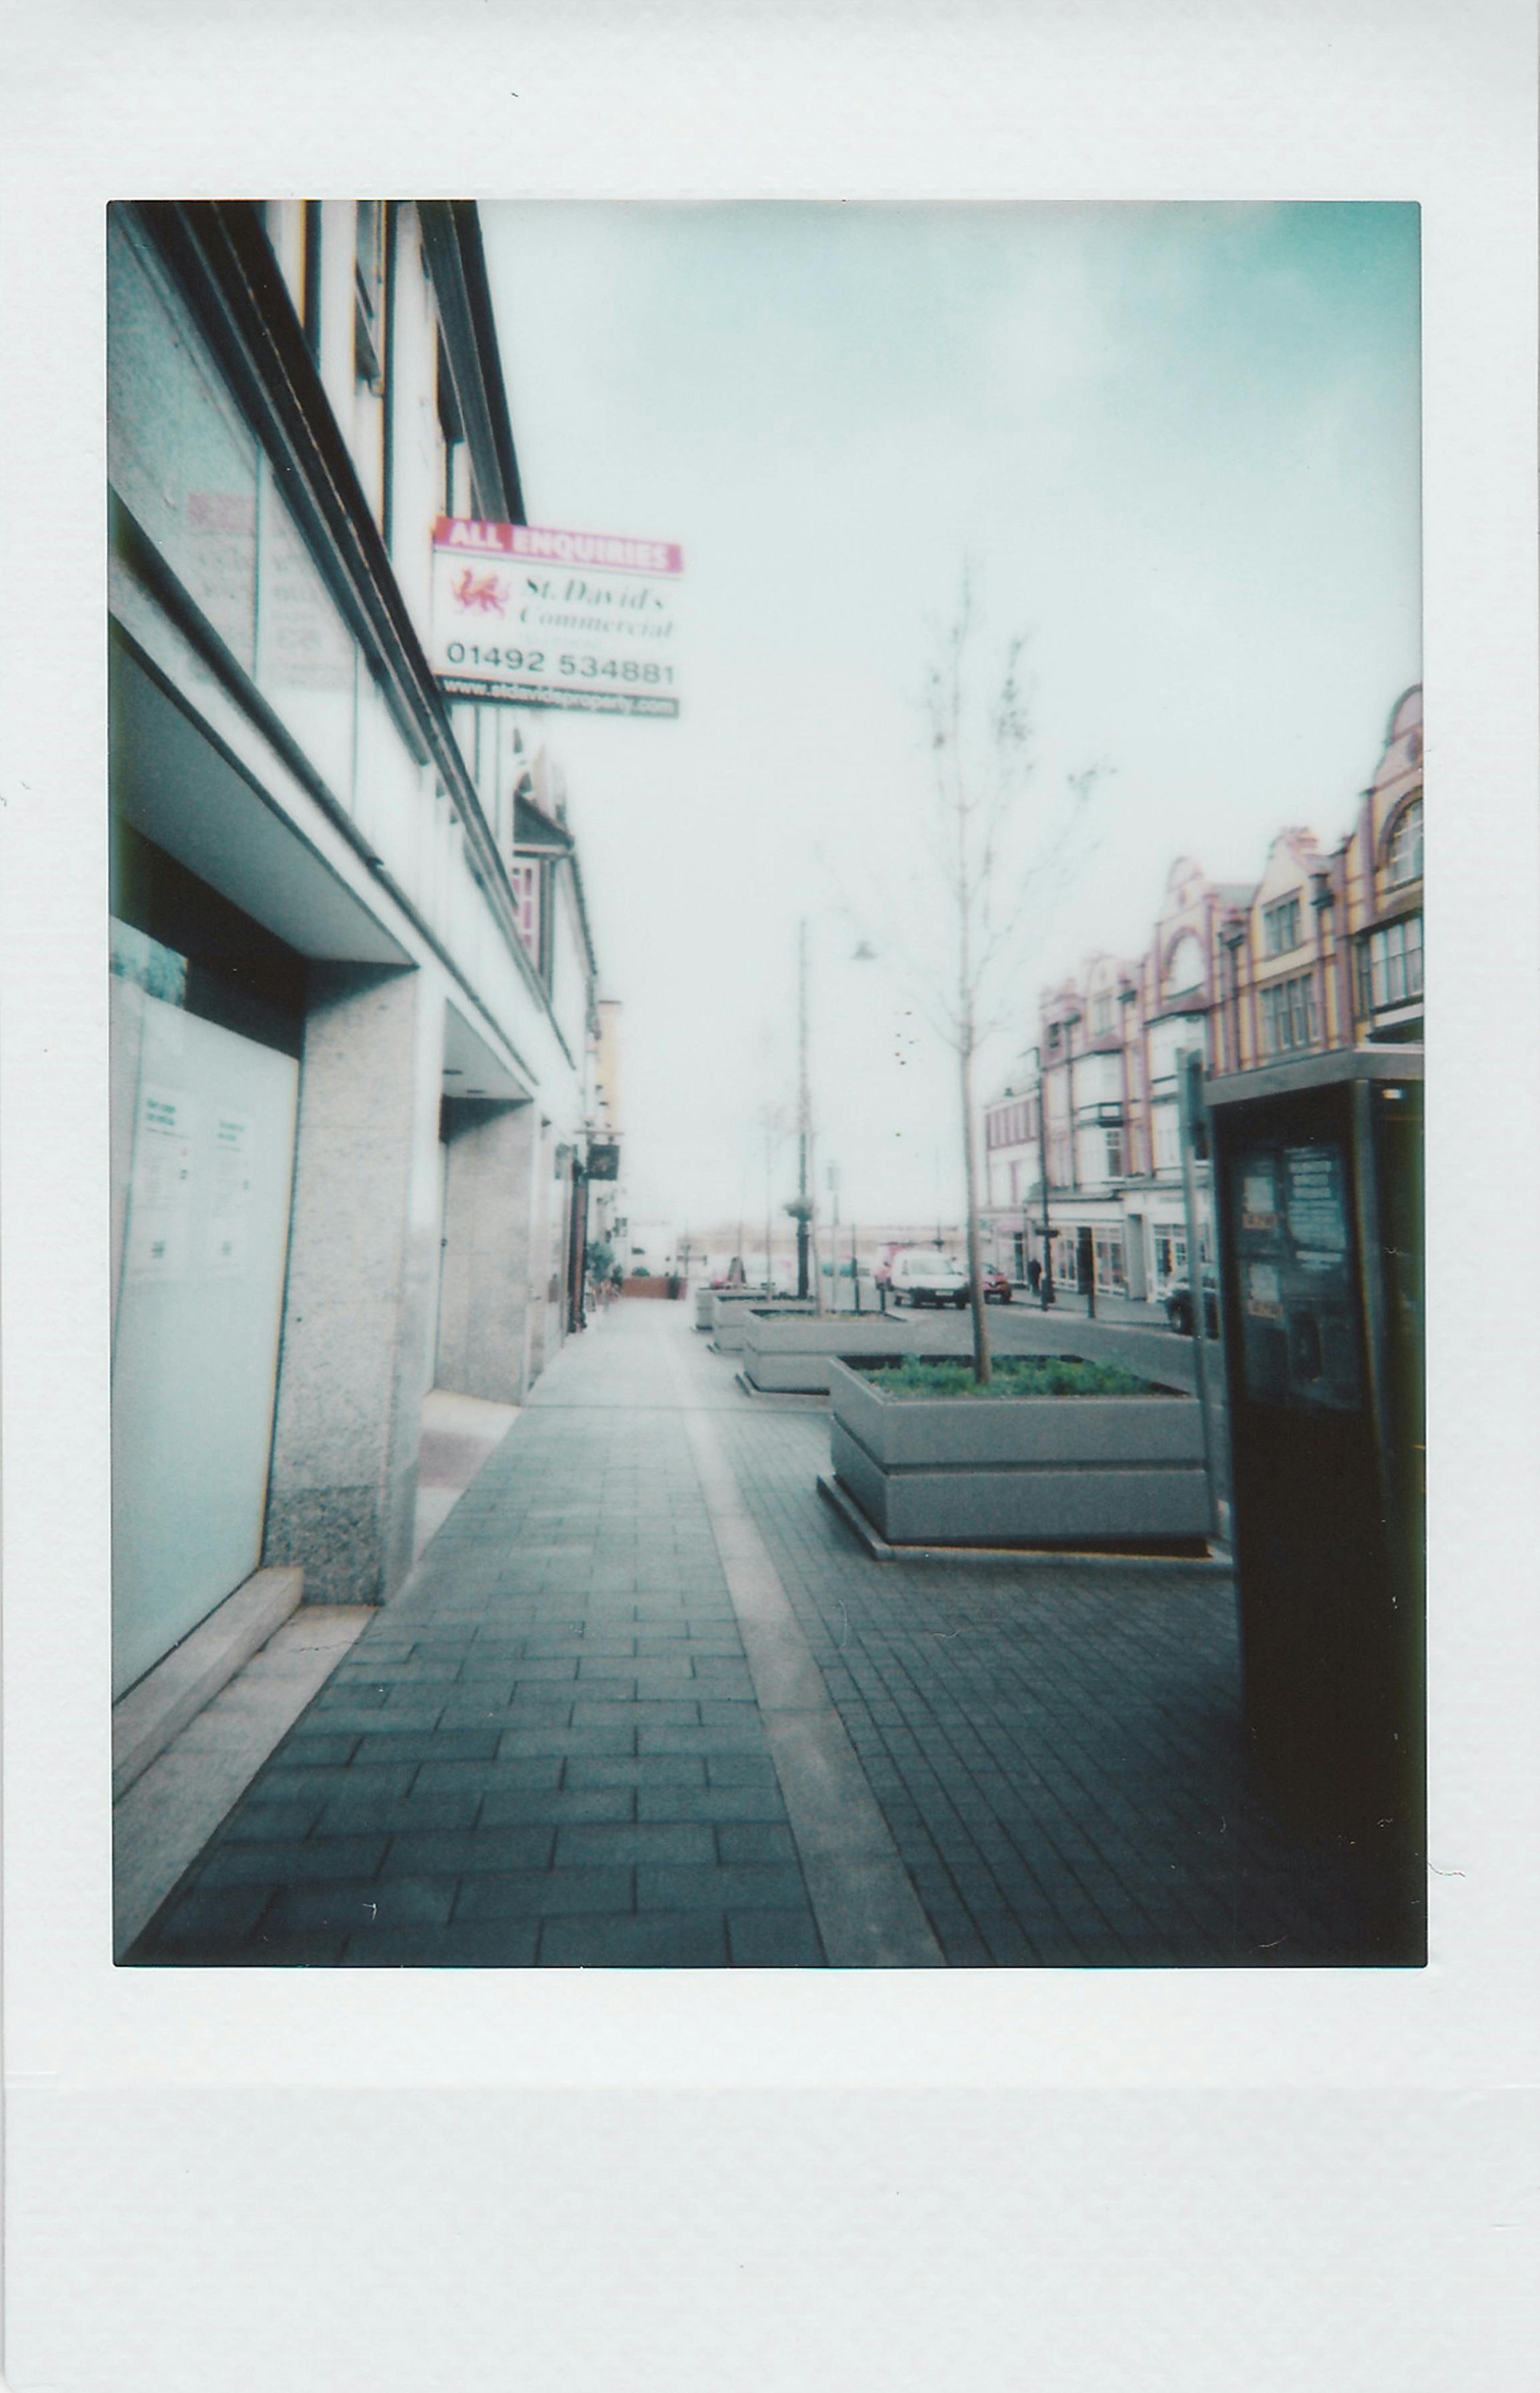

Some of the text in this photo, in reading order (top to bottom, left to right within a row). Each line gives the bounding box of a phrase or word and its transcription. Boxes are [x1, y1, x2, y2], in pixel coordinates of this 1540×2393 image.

[448, 520, 669, 569] ALL ENQUIRIES
[518, 607, 674, 639] Commercial
[447, 641, 674, 685] 01492 534881
